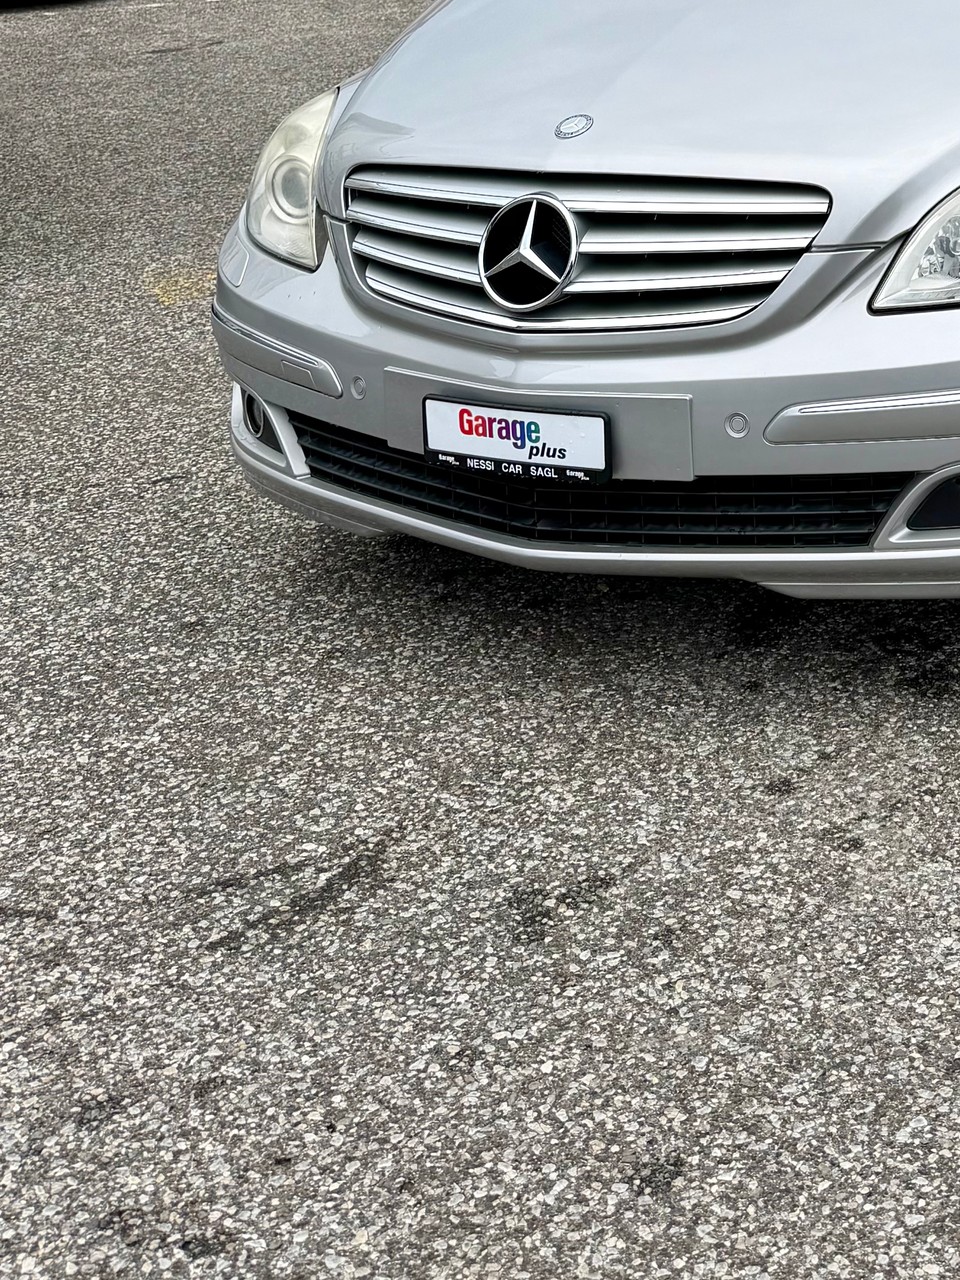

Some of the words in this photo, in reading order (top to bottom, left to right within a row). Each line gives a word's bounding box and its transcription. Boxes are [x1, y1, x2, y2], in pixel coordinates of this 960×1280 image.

[458, 408, 541, 450] Garage
[528, 442, 567, 460] plus
[466, 458, 495, 471] NESSI
[501, 463, 523, 475] CAR
[529, 466, 558, 478] SAGL
